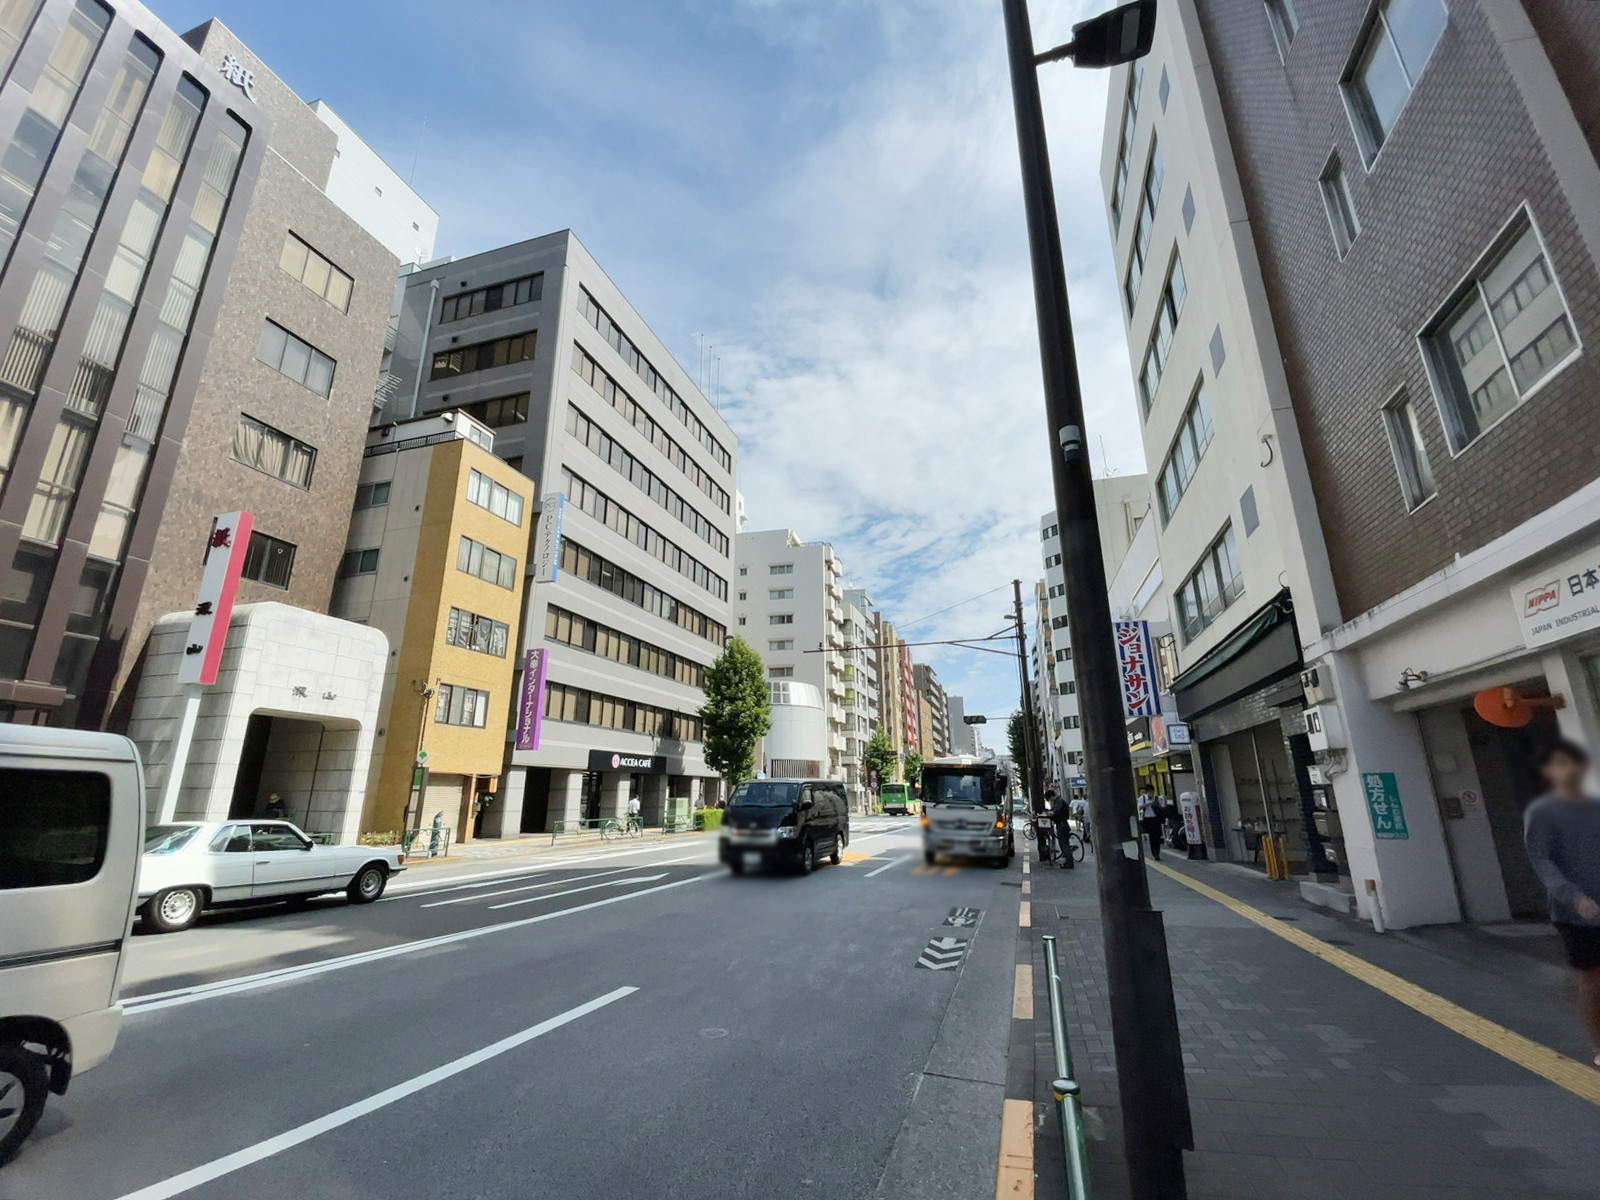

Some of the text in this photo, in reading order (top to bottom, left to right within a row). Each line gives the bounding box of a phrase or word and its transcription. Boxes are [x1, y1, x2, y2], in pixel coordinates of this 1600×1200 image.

[218, 54, 258, 104] 紙
[1567, 567, 1600, 597] 日本
[1527, 588, 1557, 610] NIPPA
[1530, 605, 1600, 636] JAPAN INDUSTRIAL
[1119, 626, 1149, 710] ジョナサン
[620, 757, 638, 767] ACCEA
[1366, 774, 1392, 830] 処方せん
